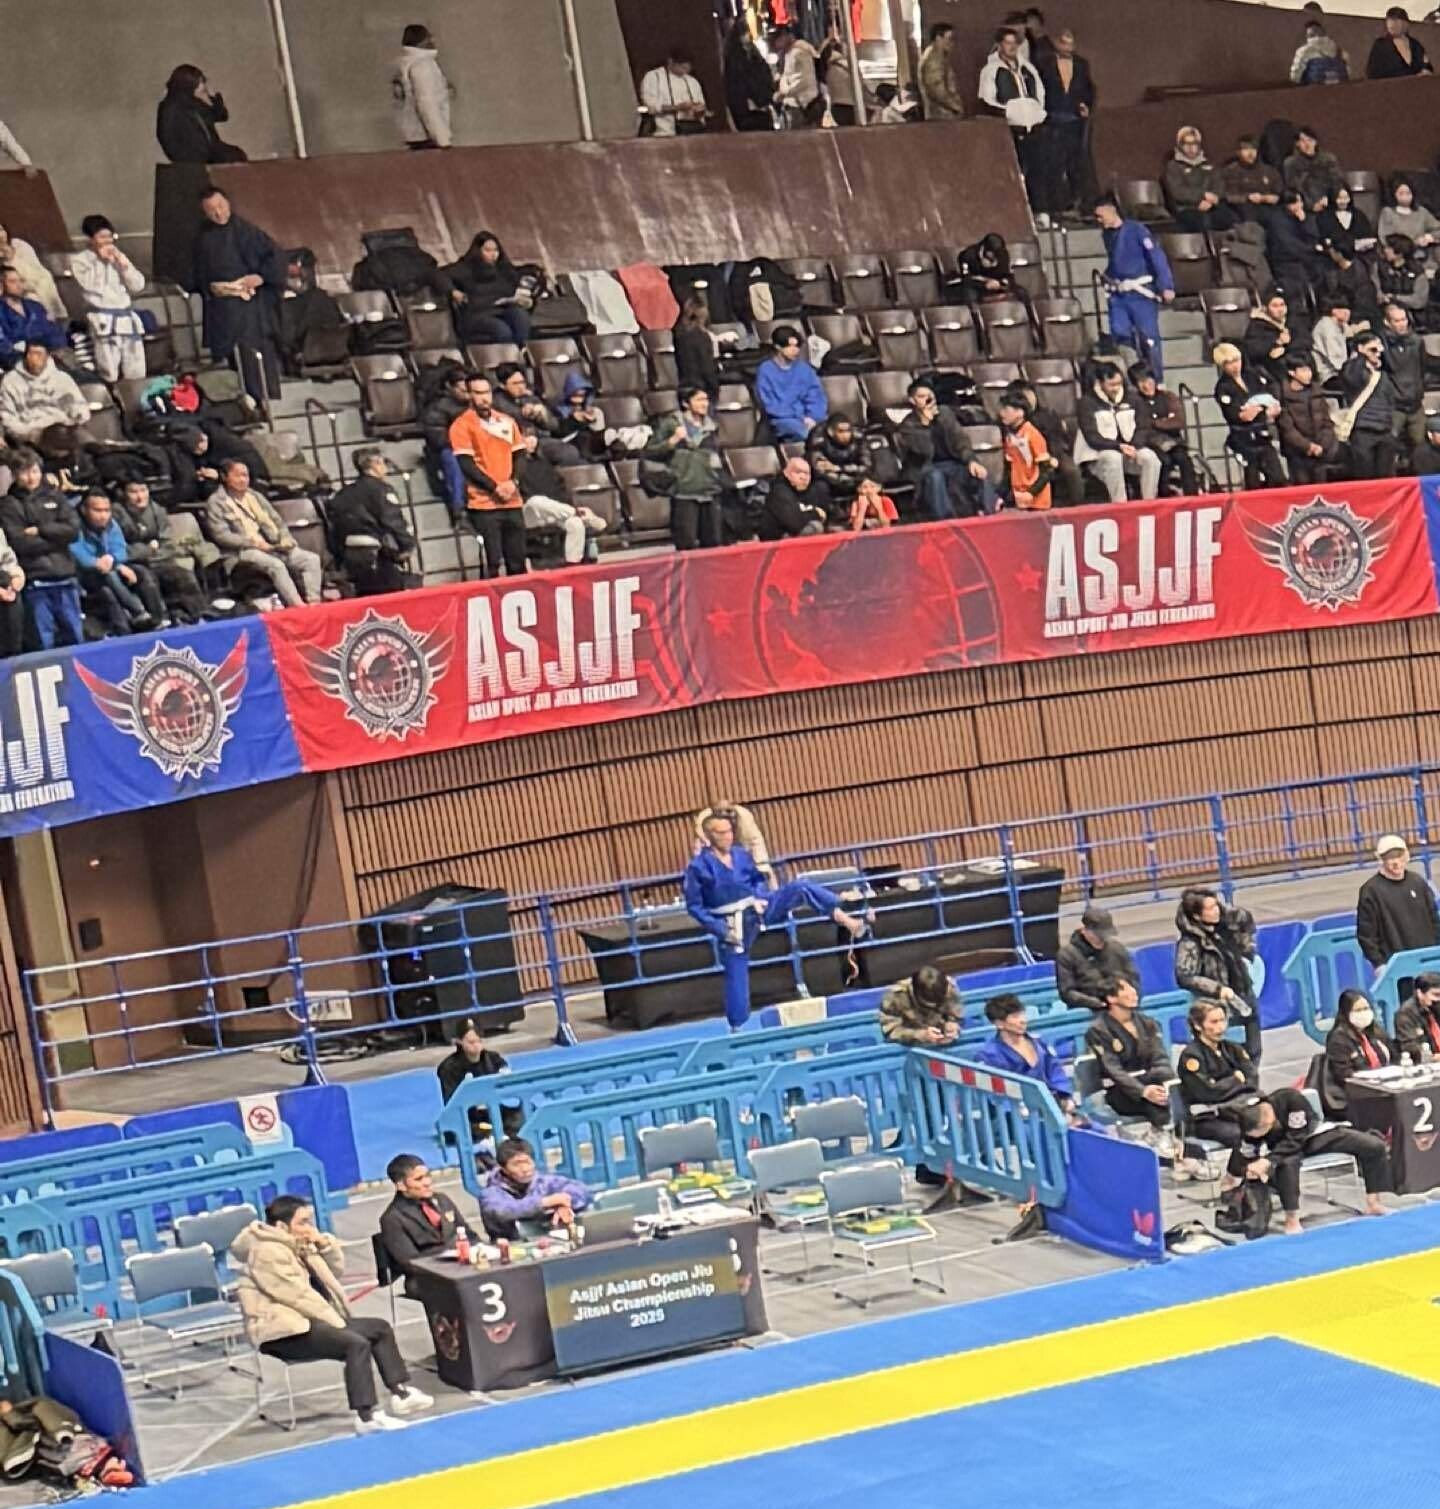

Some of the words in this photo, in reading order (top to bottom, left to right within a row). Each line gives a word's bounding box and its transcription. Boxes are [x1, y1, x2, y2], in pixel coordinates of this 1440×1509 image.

[1045, 507, 1222, 620] ASJJF
[467, 576, 640, 700] ASJJF
[1412, 1096, 1434, 1133] 2
[606, 1279, 648, 1297] Asian
[649, 1271, 688, 1291] Open
[690, 1263, 714, 1280] Jiu
[478, 1283, 507, 1323] 3
[573, 1304, 611, 1322] Jitsu
[612, 1282, 715, 1315] Championship
[630, 1308, 665, 1328] 2025
